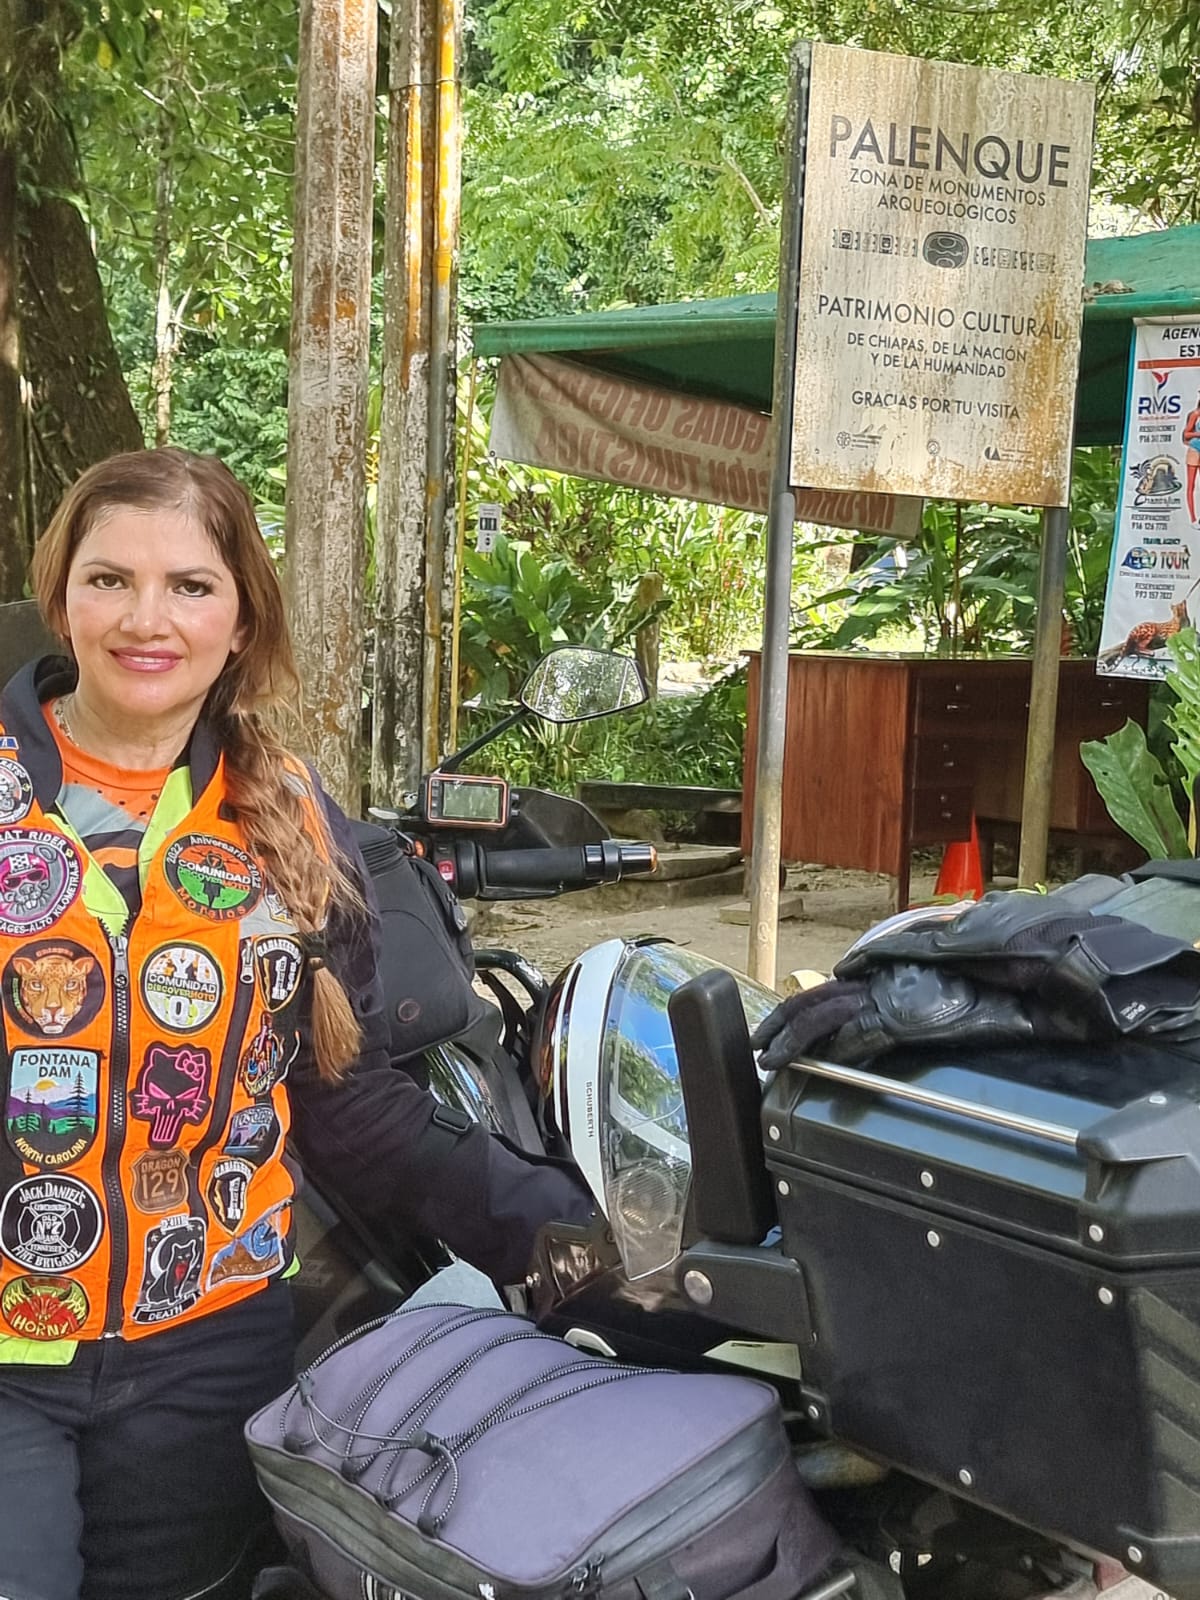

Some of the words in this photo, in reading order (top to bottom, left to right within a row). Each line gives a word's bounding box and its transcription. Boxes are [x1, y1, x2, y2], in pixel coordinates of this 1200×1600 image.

[830, 114, 1070, 187] PALENQUE
[849, 168, 898, 188] ZONA
[904, 174, 924, 191] DE
[929, 179, 1046, 206] MONUMENTOS
[877, 194, 1017, 224] ARQUEOLÓGICOS
[818, 294, 955, 328] PATRIMONIO
[963, 311, 1062, 340] CULTURAL
[848, 332, 865, 346] DE
[869, 334, 928, 352] CHIAPAS,
[933, 341, 949, 354] DE
[953, 343, 968, 357] LA
[973, 345, 1027, 362] NACIÓN
[1162, 328, 1200, 341] AGEN
[871, 353, 878, 366] Y
[883, 354, 900, 368] DE
[904, 356, 919, 370] LA
[924, 358, 1006, 378] HUMANIDAD
[852, 391, 917, 410] GRACIAS
[922, 397, 950, 414] POR
[955, 400, 974, 416] TU
[977, 402, 1020, 420] VISITA
[1138, 395, 1181, 415] RMS
[0, 830, 23, 841] AT
[29, 831, 67, 849] RIDER
[190, 836, 248, 861] Aniversario
[178, 859, 251, 884] COMUNIDAD
[149, 973, 216, 993] COMUNIDAD
[20, 1053, 91, 1068] FONTANA
[39, 1066, 71, 1078] DAM
[15, 1137, 42, 1164] NORTH
[45, 1138, 88, 1165] CAROLINA
[141, 1157, 181, 1173] DRAGON
[19, 1185, 44, 1204] JACK
[142, 1169, 179, 1200] 129
[36, 1248, 82, 1268] BRIGADE
[148, 1304, 183, 1321] DEATH
